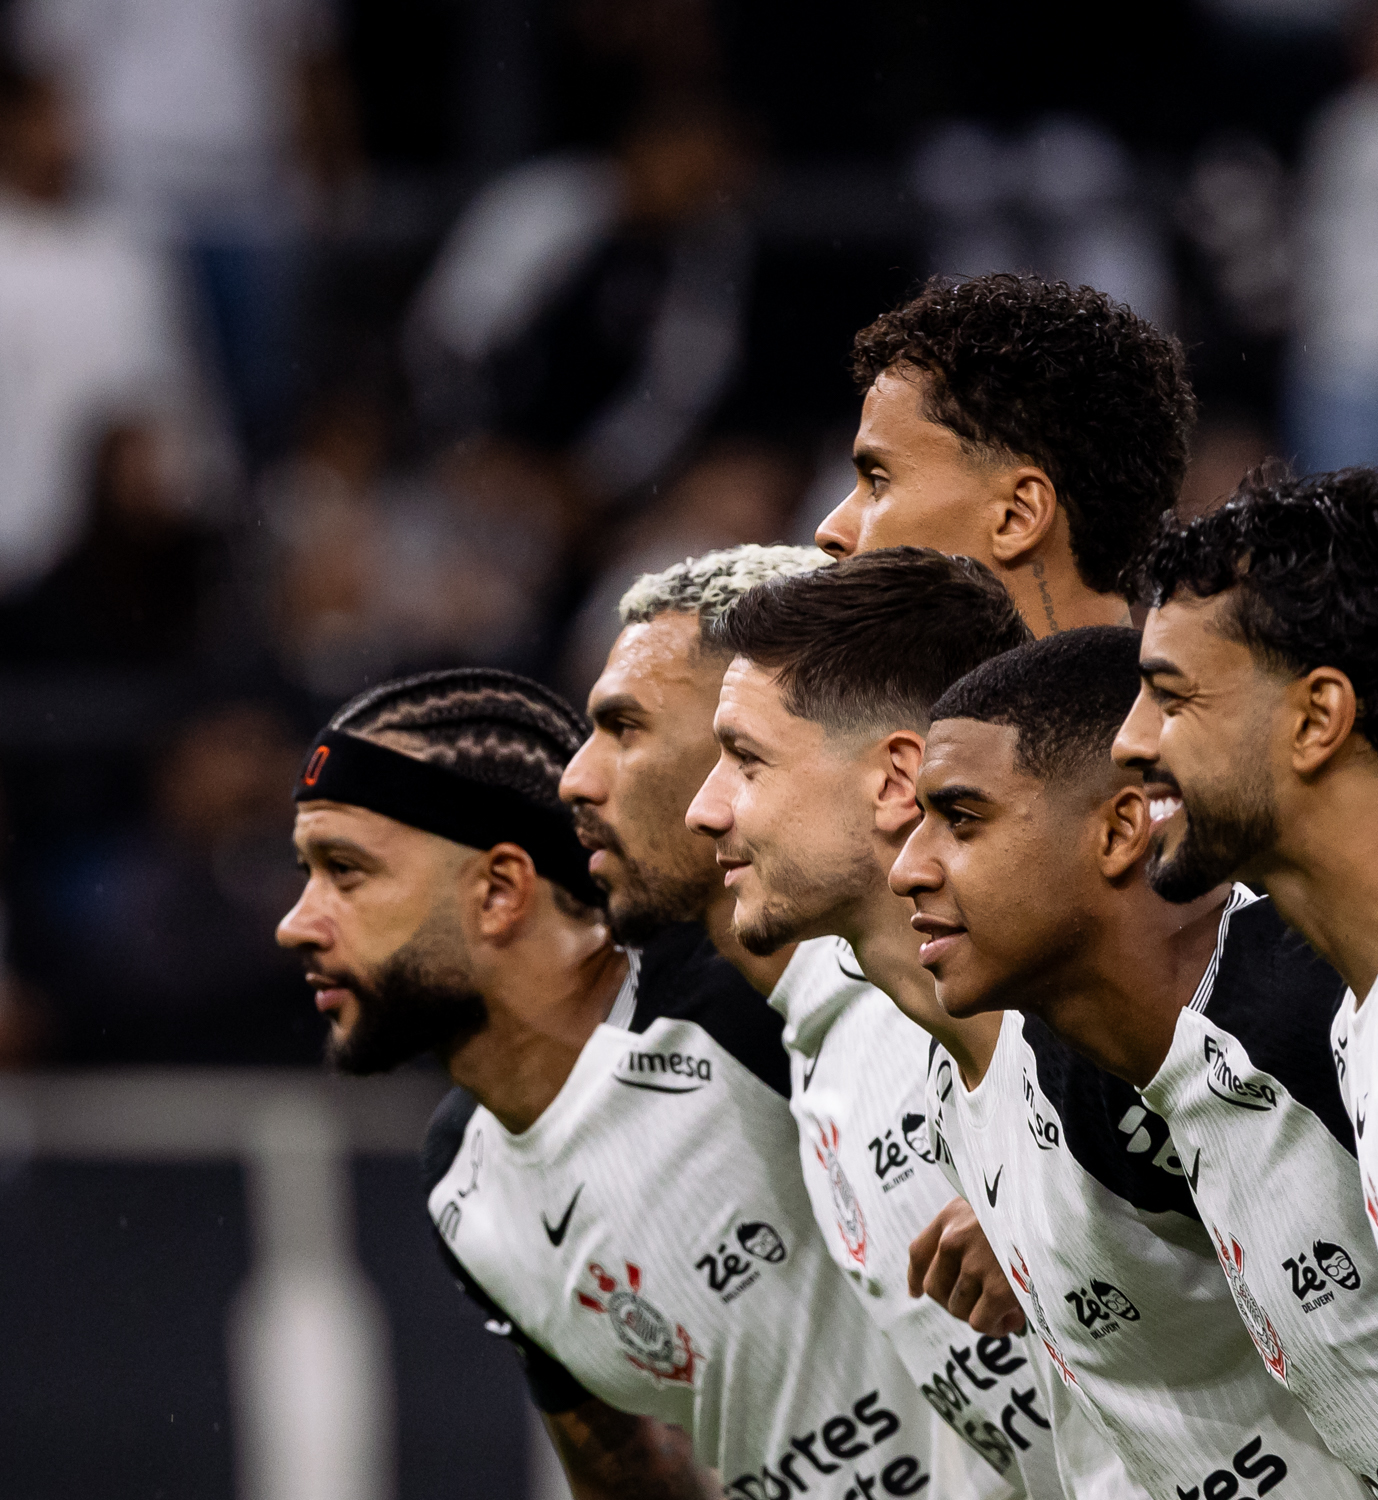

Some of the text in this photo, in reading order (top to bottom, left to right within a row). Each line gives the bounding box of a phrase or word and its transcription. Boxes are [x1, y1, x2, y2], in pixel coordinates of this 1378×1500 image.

[1204, 1034, 1277, 1107] Frimesa
[867, 1128, 908, 1180] Zé
[695, 1243, 751, 1292] Zé
[1281, 1252, 1326, 1301] Zé
[1064, 1287, 1110, 1329] Zé
[1301, 1290, 1335, 1314] DELIVERY
